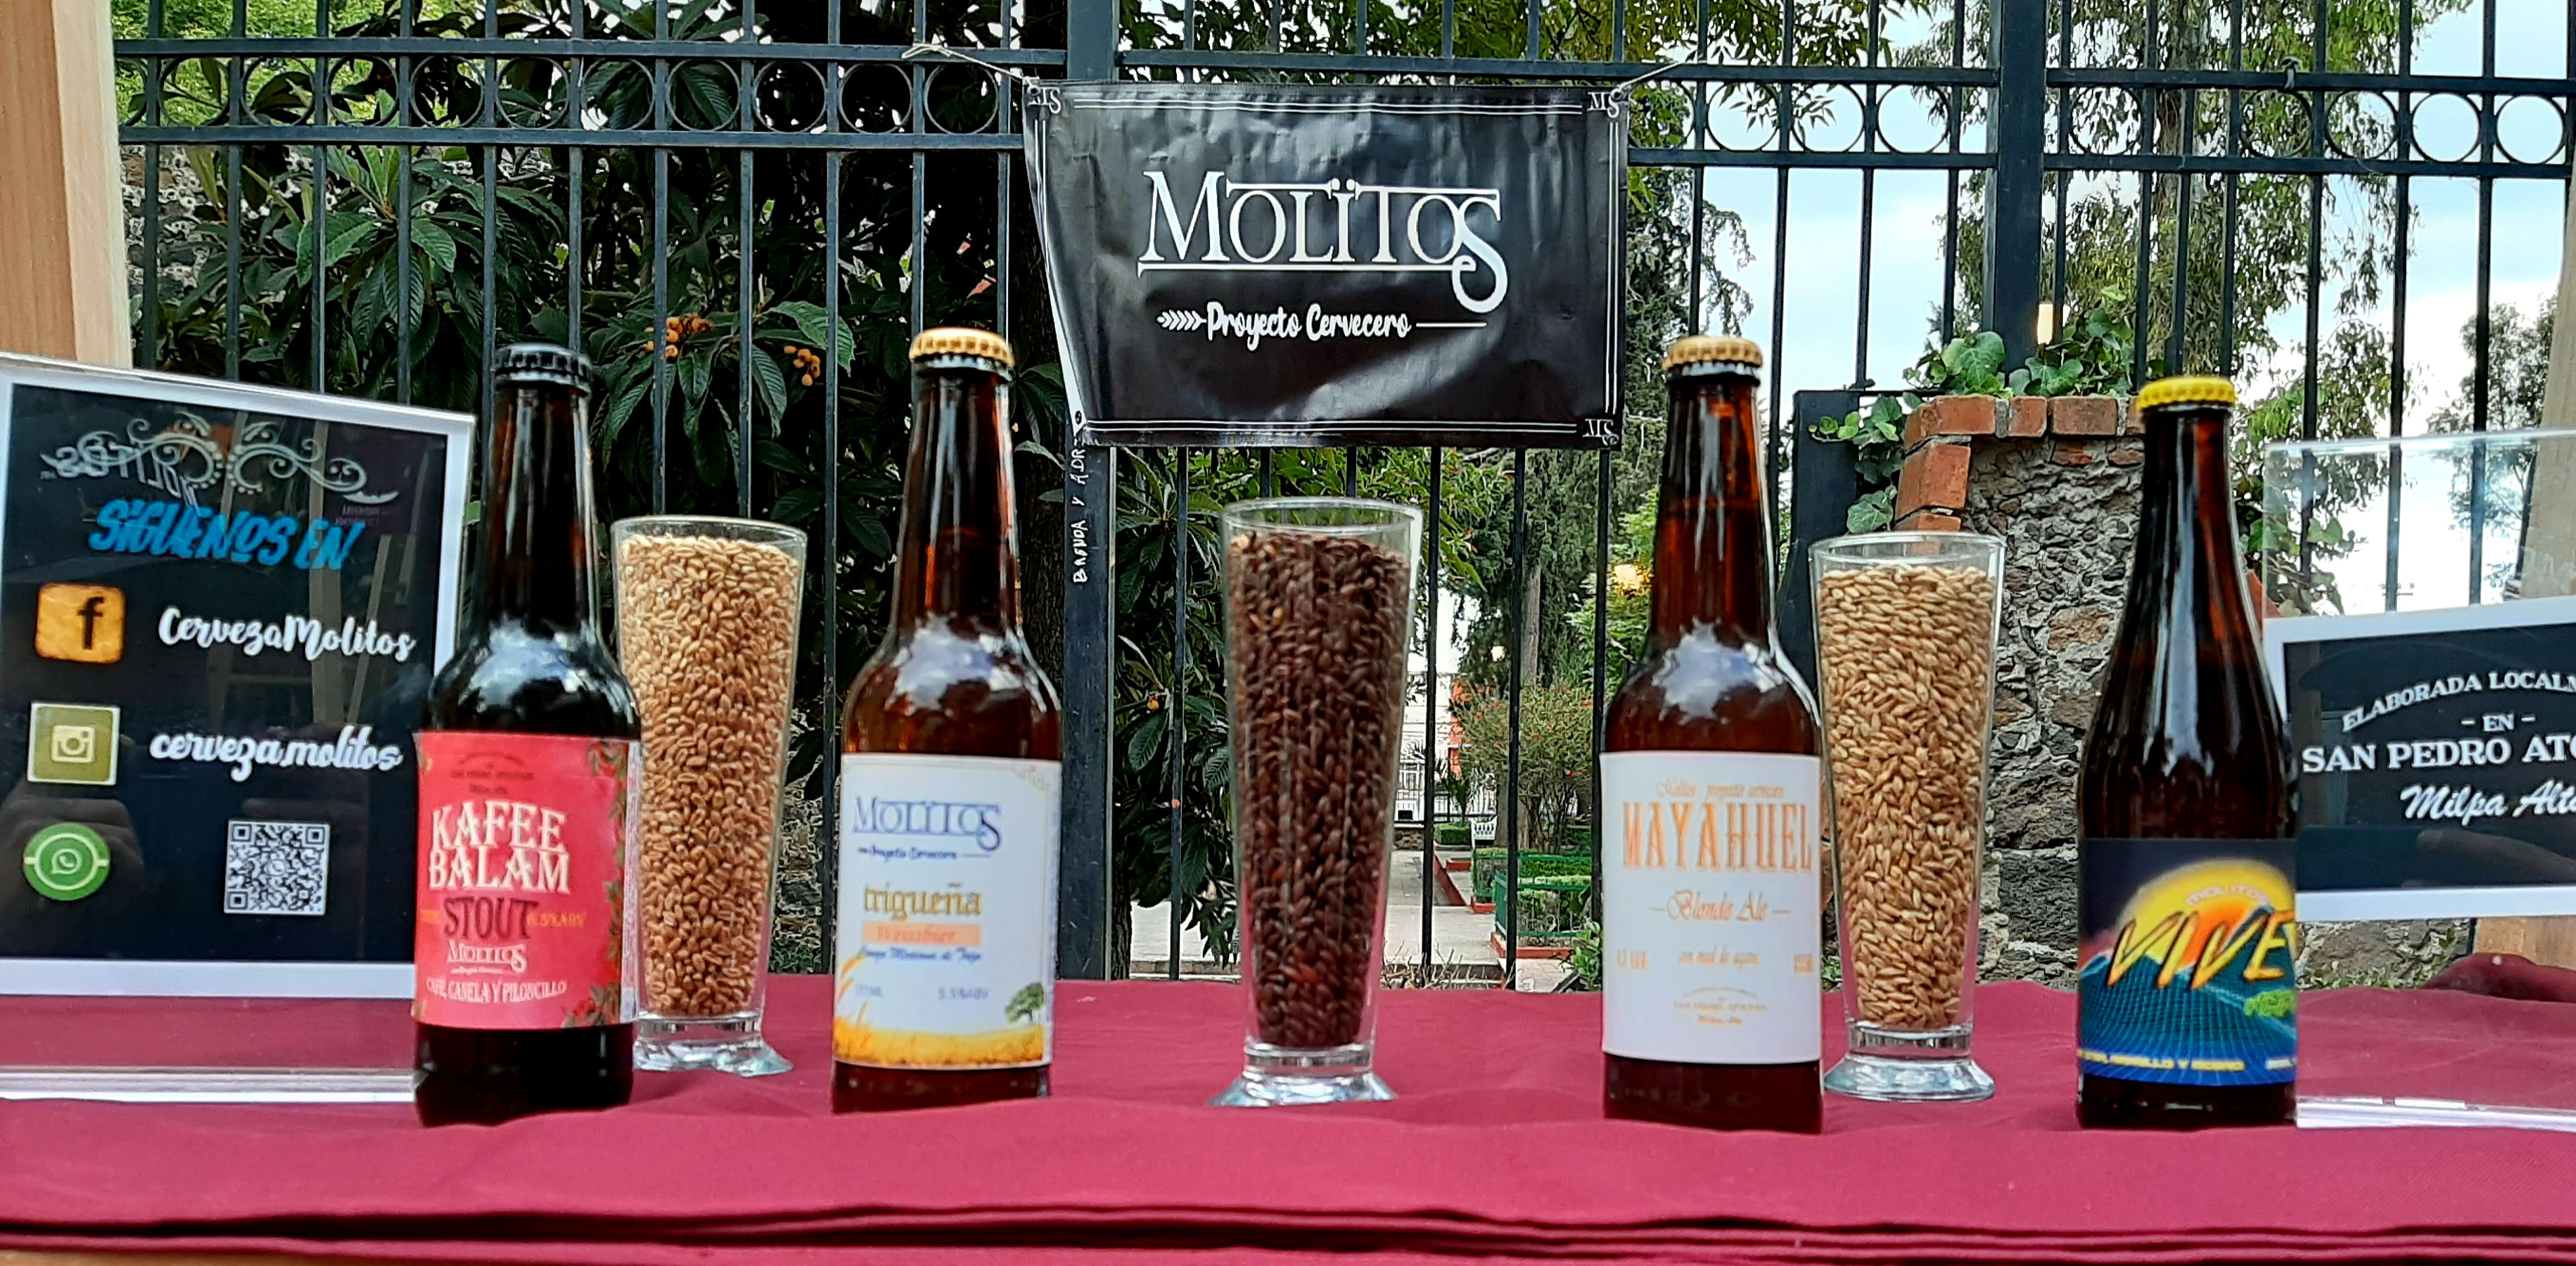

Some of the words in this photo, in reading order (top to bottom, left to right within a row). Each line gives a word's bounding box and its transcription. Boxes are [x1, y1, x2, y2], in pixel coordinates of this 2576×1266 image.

[1206, 301, 1302, 351] Proyecto
[1306, 303, 1412, 341] Cervecero
[293, 518, 366, 570] EN
[159, 606, 417, 662] CervezaMolitos
[2342, 673, 2482, 732] ELABORADA
[2482, 713, 2515, 732] EN
[2303, 744, 2377, 774] SAN
[2387, 736, 2512, 769] PEDRO
[2522, 733, 2576, 763] AT
[432, 799, 568, 853] KAFEE
[2400, 782, 2507, 826] Milpa
[1623, 801, 1812, 872] MAYAHUEL
[429, 844, 570, 895] BALAM
[443, 896, 538, 940] STOUT
[1735, 890, 1768, 922] Ale
[501, 979, 568, 1003] PILONCILLO
